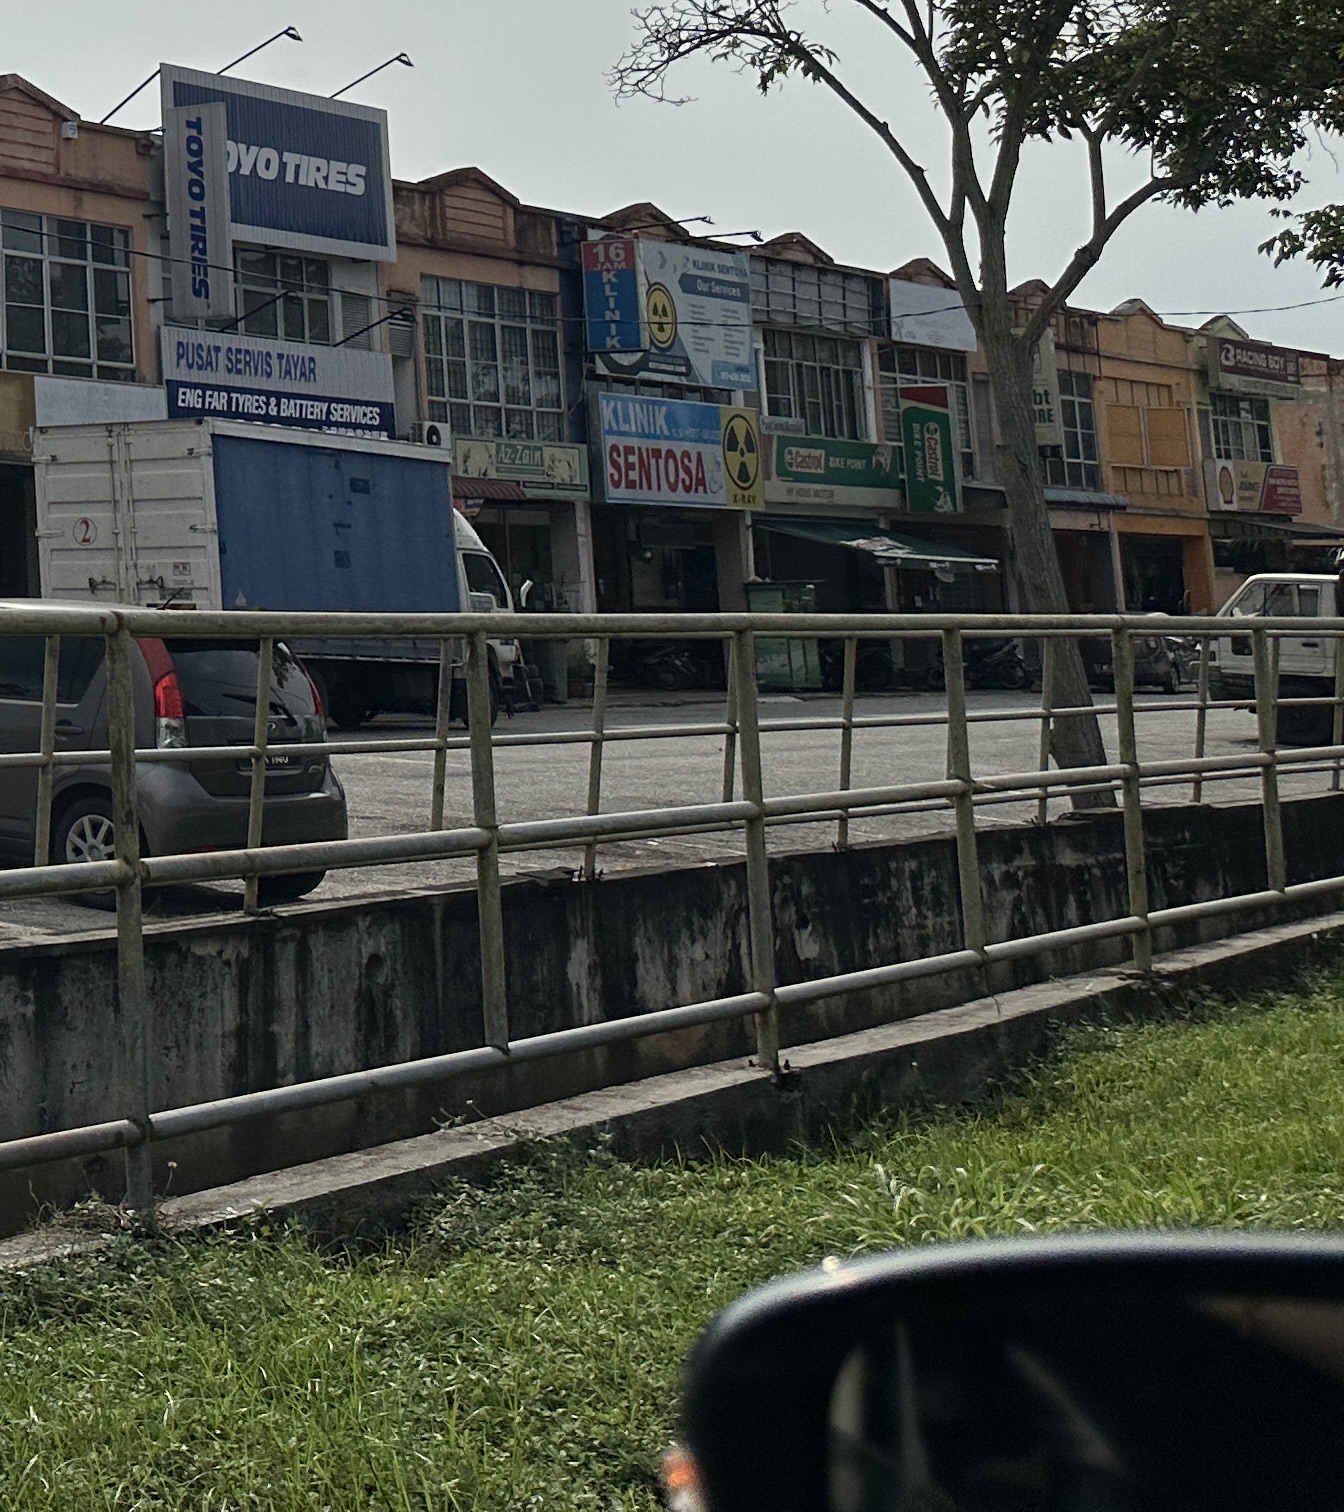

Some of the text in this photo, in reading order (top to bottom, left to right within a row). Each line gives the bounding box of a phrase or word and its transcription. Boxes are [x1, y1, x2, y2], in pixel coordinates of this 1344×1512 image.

[226, 139, 367, 196] OYO TIRES
[185, 117, 209, 300] TOYO TIRES
[592, 243, 625, 263] 16
[593, 261, 626, 270] JAM
[601, 270, 621, 349] KLINIK
[176, 340, 316, 383] PUSAT SERVIS TAYAR
[177, 387, 380, 426] ENG FAR TYRES & BATTERY SERVICES
[602, 399, 670, 436] KLINIK
[498, 444, 542, 466] Az-Zain
[608, 443, 708, 494] SENTOSA
[794, 450, 823, 471] Castrol
[912, 423, 925, 483] BIKE POINT
[926, 437, 941, 478] Castrol
[732, 494, 756, 505] X-RAY
[80, 519, 91, 543] 2
